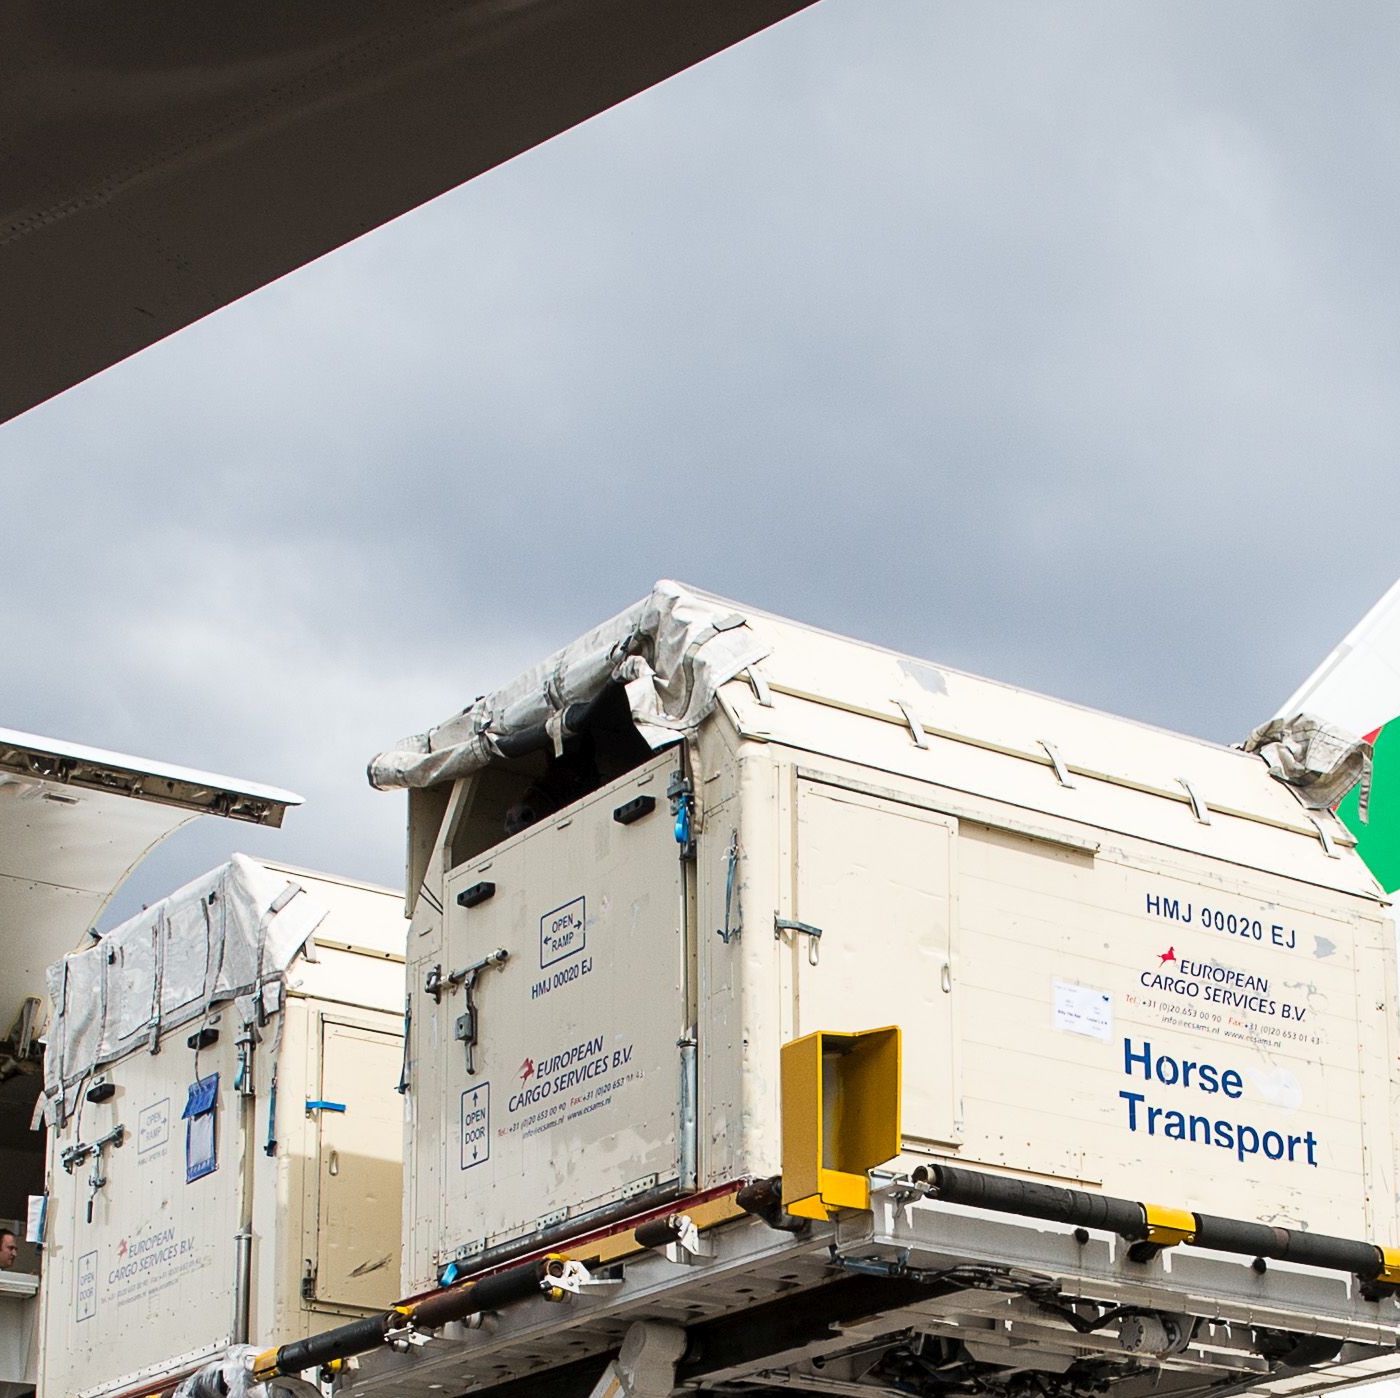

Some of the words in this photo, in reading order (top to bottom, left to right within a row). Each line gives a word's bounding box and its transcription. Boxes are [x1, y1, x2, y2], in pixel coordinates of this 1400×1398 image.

[551, 913, 573, 933] OPEN
[551, 931, 574, 952] RAMP
[1146, 893, 1192, 923] HMJ
[1201, 908, 1262, 940] 00020
[1272, 925, 1296, 949] EJ
[531, 978, 551, 1000] HMJ
[553, 964, 579, 988] 00020
[581, 957, 592, 975] EJ
[1140, 972, 1199, 997] CARGO
[1204, 986, 1276, 1015] SERVICES
[1180, 959, 1269, 993] EUROPEAN
[536, 1035, 604, 1079] EUROPEAN
[1124, 1038, 1243, 1098] Horse
[508, 1082, 550, 1113] CARGO
[553, 1056, 608, 1094] SERVICES
[611, 1045, 633, 1068] B.V.
[465, 1108, 486, 1126] OPEN
[465, 1126, 485, 1145] DOOR
[1119, 1090, 1318, 1168] Transport
[129, 1226, 175, 1258] EUROPEAN
[108, 1261, 138, 1285] CARGO
[138, 1243, 178, 1272] SERVICES
